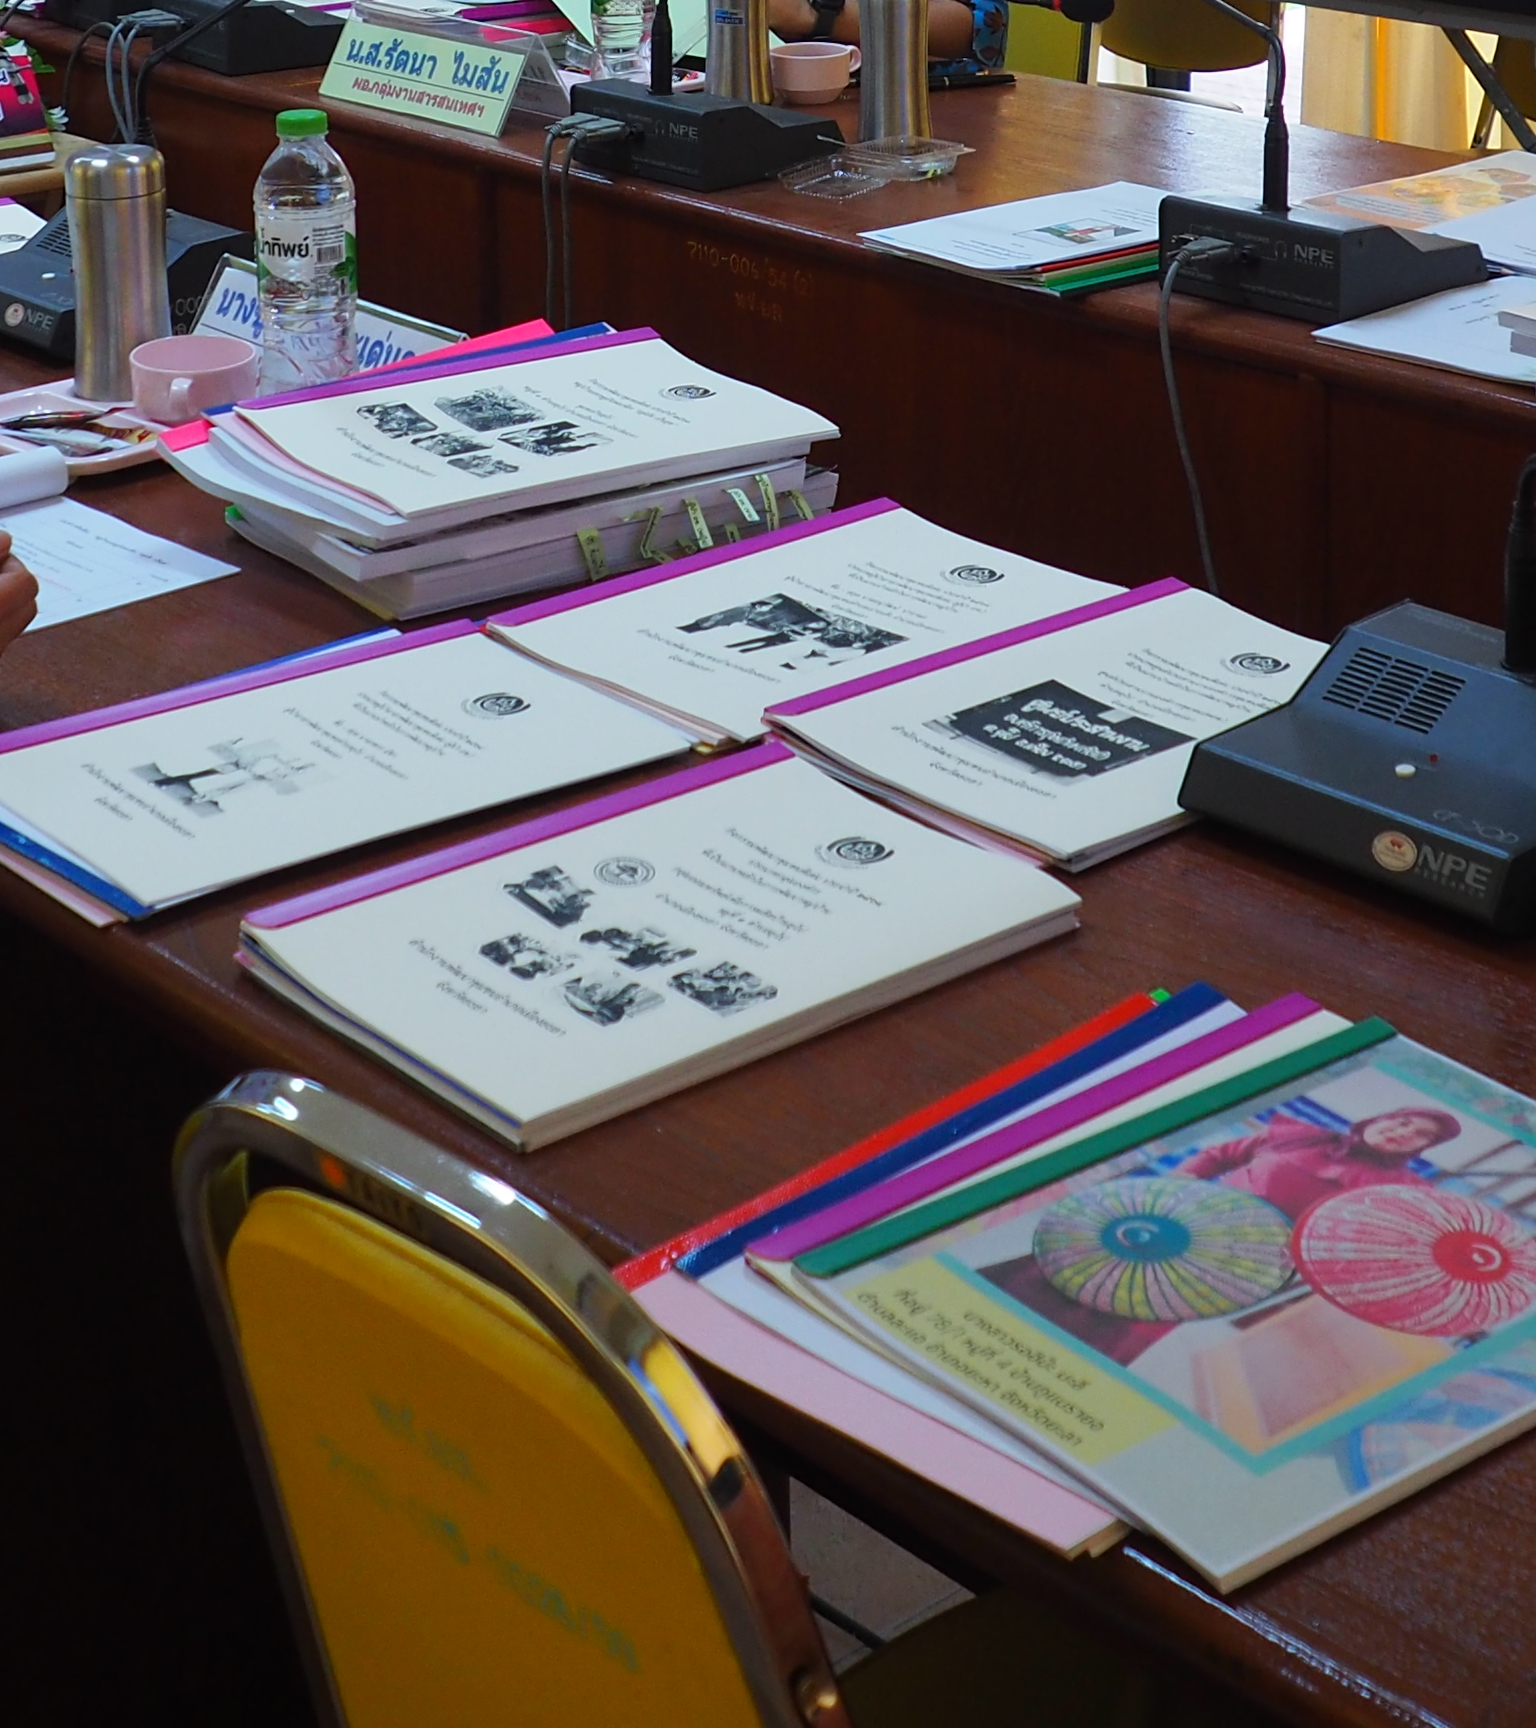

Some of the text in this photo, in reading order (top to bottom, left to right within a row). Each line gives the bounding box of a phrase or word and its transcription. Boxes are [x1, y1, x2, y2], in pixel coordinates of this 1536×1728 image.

[669, 122, 699, 139] NPE
[1294, 243, 1334, 265] NPE
[24, 308, 54, 331] NPE
[1416, 842, 1492, 892] NPE
